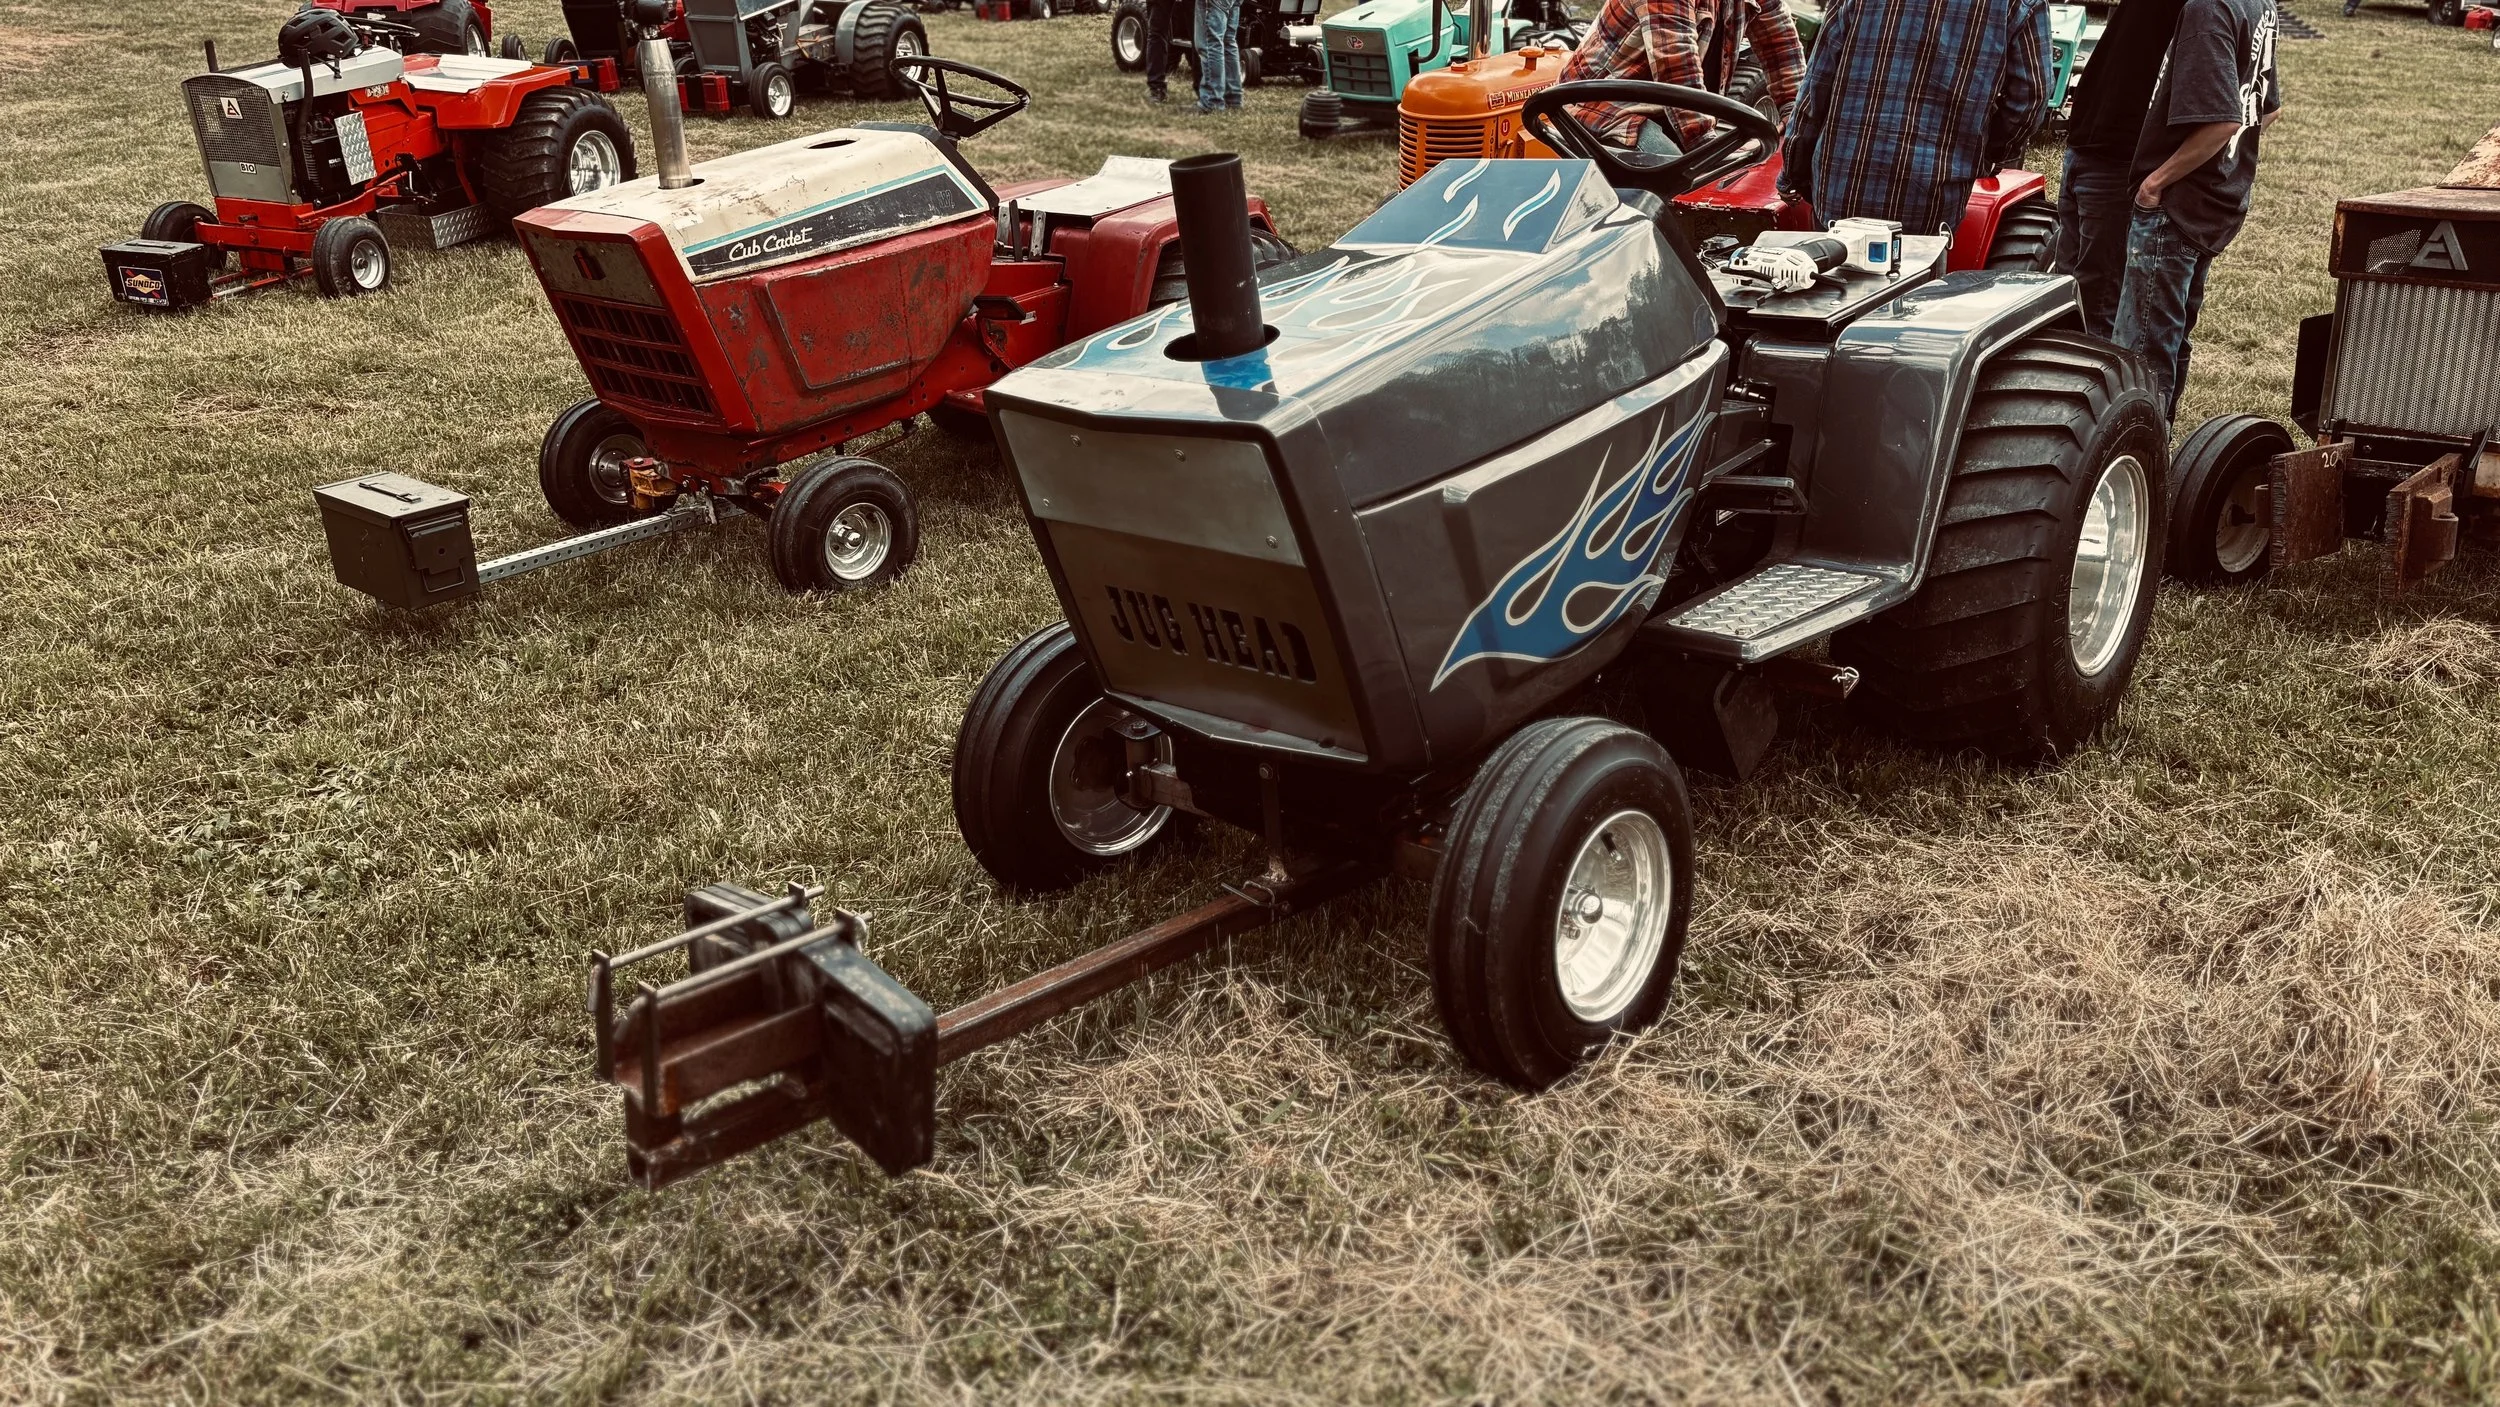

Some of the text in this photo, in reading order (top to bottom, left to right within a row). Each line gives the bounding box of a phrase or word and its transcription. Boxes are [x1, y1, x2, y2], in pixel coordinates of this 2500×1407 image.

[240, 163, 255, 172] B10
[728, 227, 813, 261] Cub Cadet
[126, 279, 161, 290] SUNOCO
[1105, 584, 1317, 684] JUG HEAD
